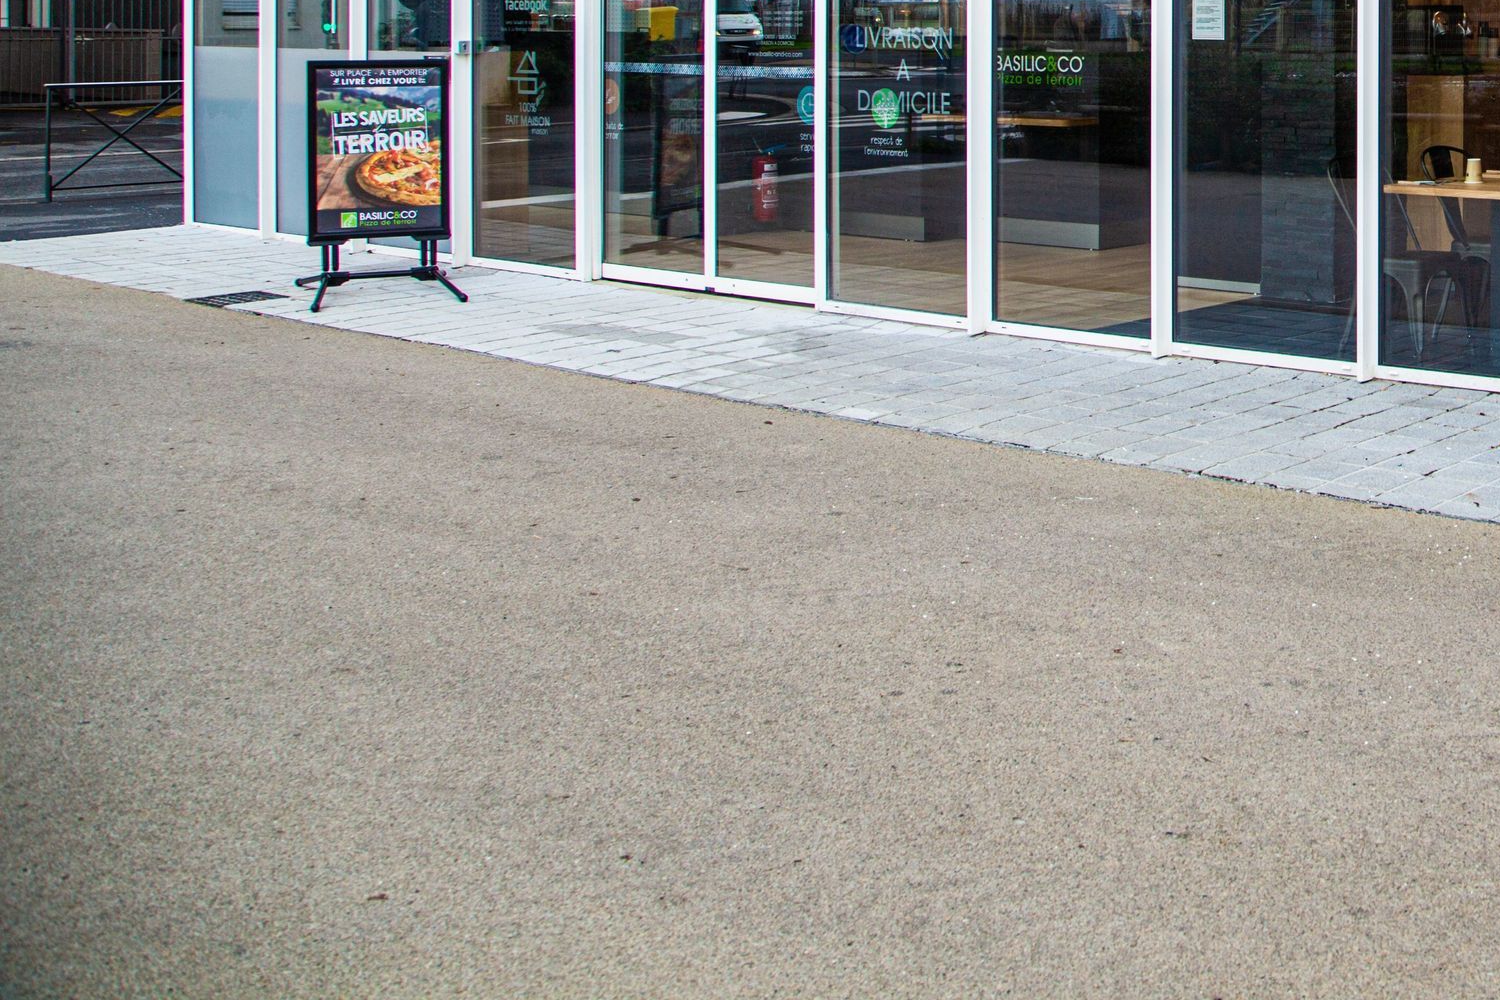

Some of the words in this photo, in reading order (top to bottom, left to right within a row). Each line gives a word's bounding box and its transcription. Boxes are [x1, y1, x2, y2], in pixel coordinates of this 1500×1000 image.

[856, 26, 953, 49] LIVRAISON
[347, 69, 371, 77] PLACE
[387, 68, 428, 76] EMPORTER
[341, 77, 365, 86] LIVRÉ
[368, 77, 391, 85] CHEZ
[392, 77, 417, 85] VOUS
[1027, 74, 1042, 85] de
[1046, 74, 1083, 86] terroir
[519, 102, 537, 113] 100%
[857, 89, 951, 115] DOMICILE
[333, 110, 358, 128] LES
[359, 107, 426, 127] SAVEURS
[505, 114, 519, 126] FAIT
[520, 114, 551, 127] MAISON
[334, 130, 426, 155] TERROIR
[871, 136, 893, 147] respect
[895, 137, 903, 146] de
[359, 210, 417, 220] BASILIC&CO
